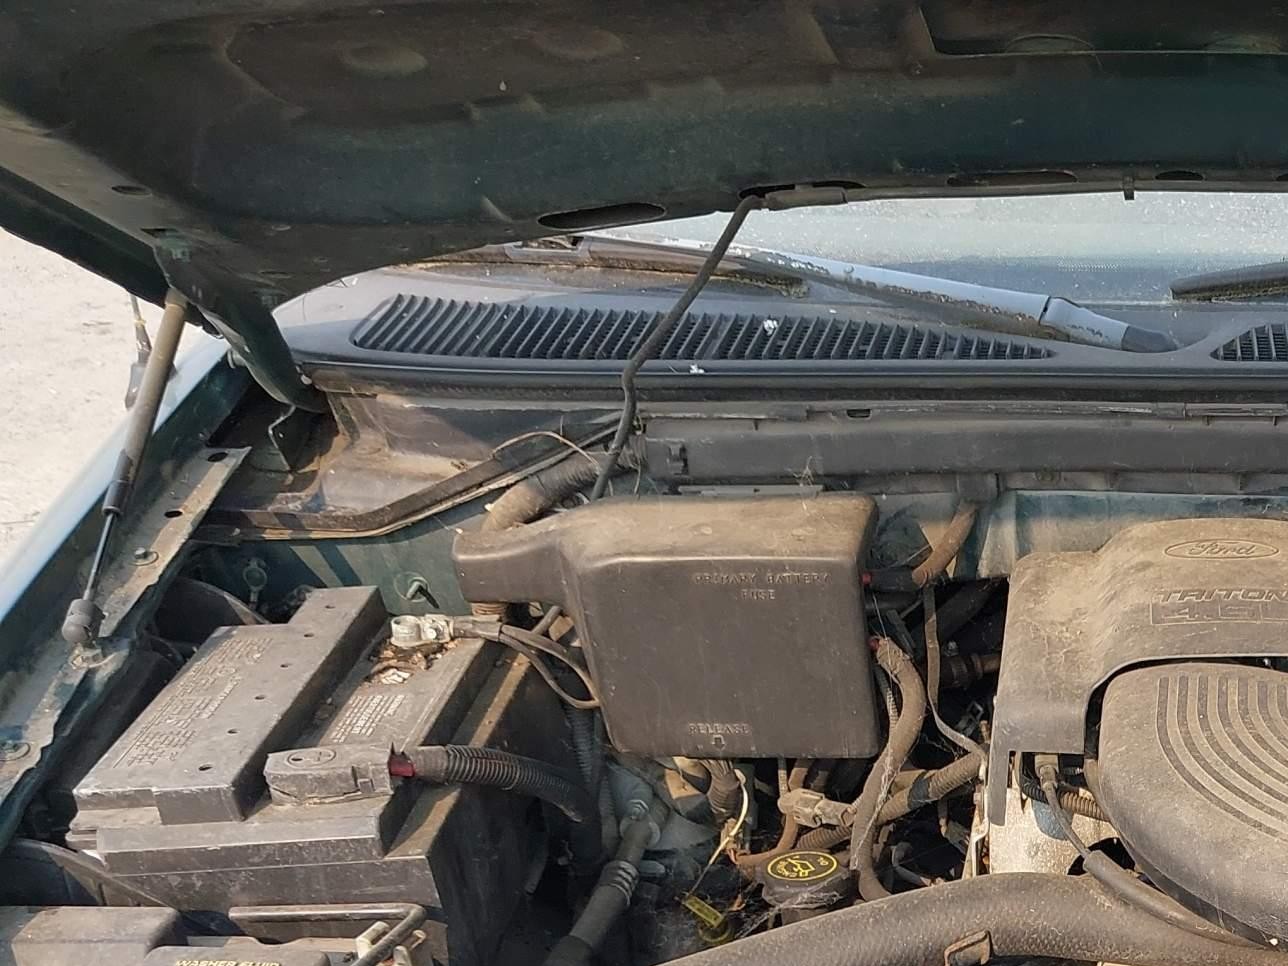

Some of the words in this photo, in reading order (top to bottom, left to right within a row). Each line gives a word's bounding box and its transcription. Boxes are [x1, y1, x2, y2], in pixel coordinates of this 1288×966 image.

[1188, 541, 1257, 556] Ford
[694, 572, 759, 585] PRIMARY
[766, 572, 833, 585] BATTERY
[741, 588, 777, 601] FUSE
[688, 722, 751, 735] RELEASE
